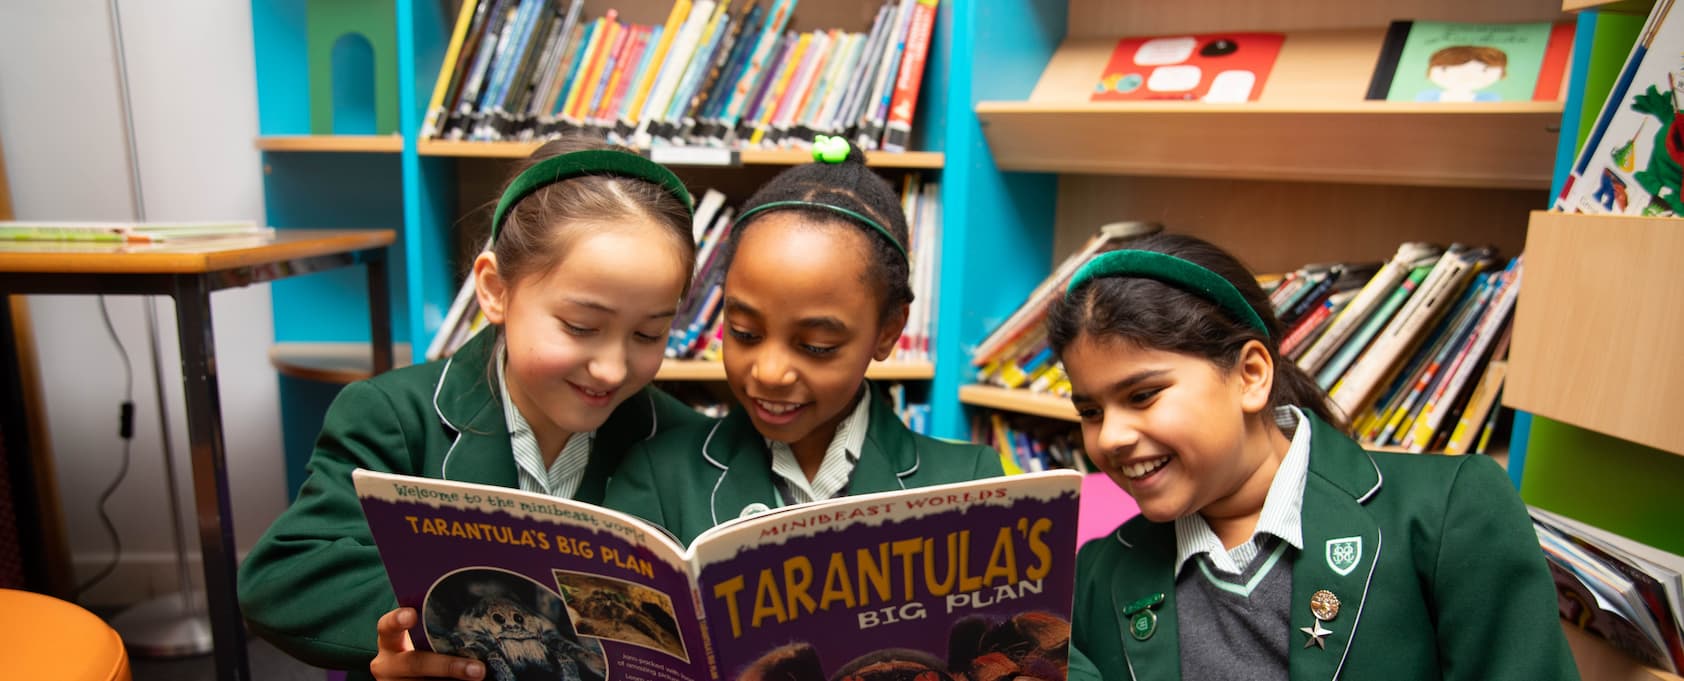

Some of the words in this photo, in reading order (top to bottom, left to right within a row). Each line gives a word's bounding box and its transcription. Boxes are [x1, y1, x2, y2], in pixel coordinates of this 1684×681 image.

[393, 483, 459, 503] Welcome
[463, 493, 482, 504] to
[487, 495, 514, 508] the
[519, 502, 600, 526] minibeast
[603, 520, 646, 543] world
[759, 502, 897, 539] MINIBEAST
[906, 488, 1008, 511] WORLDS
[405, 515, 551, 550] TARANTULA'S
[555, 535, 594, 560] BIG
[600, 545, 655, 580] PLAN
[713, 517, 1053, 639] TARANTULA'S
[857, 602, 928, 630] BIG
[946, 578, 1044, 614] PLAN
